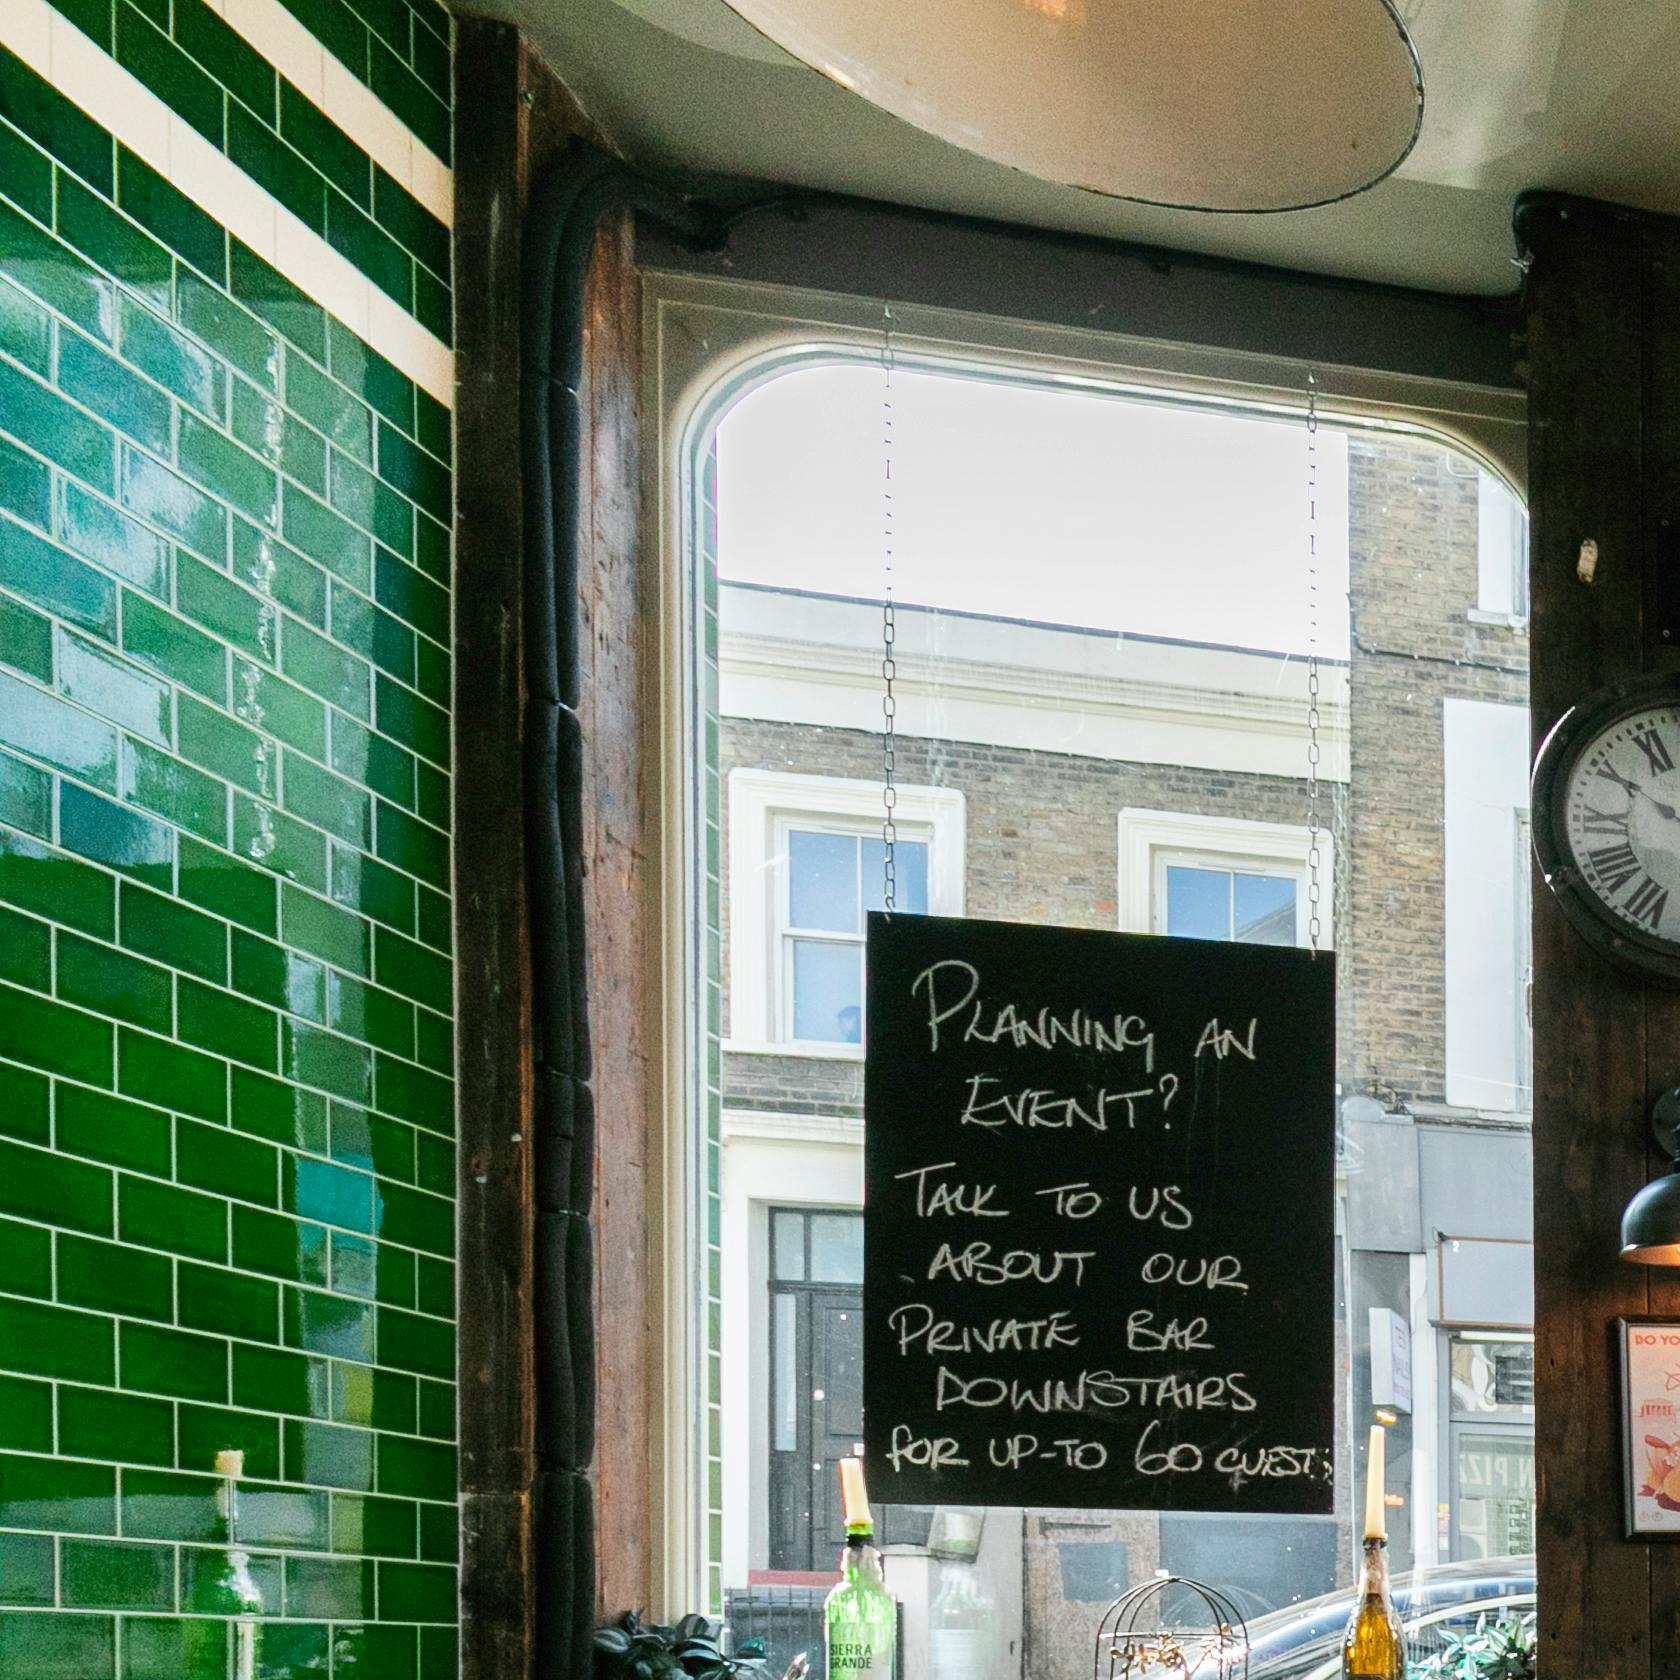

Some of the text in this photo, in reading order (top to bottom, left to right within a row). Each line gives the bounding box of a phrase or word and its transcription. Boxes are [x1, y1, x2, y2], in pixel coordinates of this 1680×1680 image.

[1632, 728, 1676, 777] XI
[1596, 760, 1641, 798] X
[1583, 804, 1629, 835] IX
[911, 959, 1257, 1074] PLANNING AN
[960, 1073, 1179, 1133] EVENT?
[1035, 1183, 1102, 1218] TO
[1128, 1185, 1194, 1230] US
[928, 1242, 1250, 1292] ABOUT OUR
[889, 1303, 1216, 1358] PRIVATE BAR
[1634, 1335, 1657, 1346] DO
[936, 1366, 1258, 1414] DOWNSTAIRS
[1134, 1419, 1201, 1476] 60
[830, 1643, 872, 1656] SIERRA
[830, 1657, 873, 1669] GRANDE
